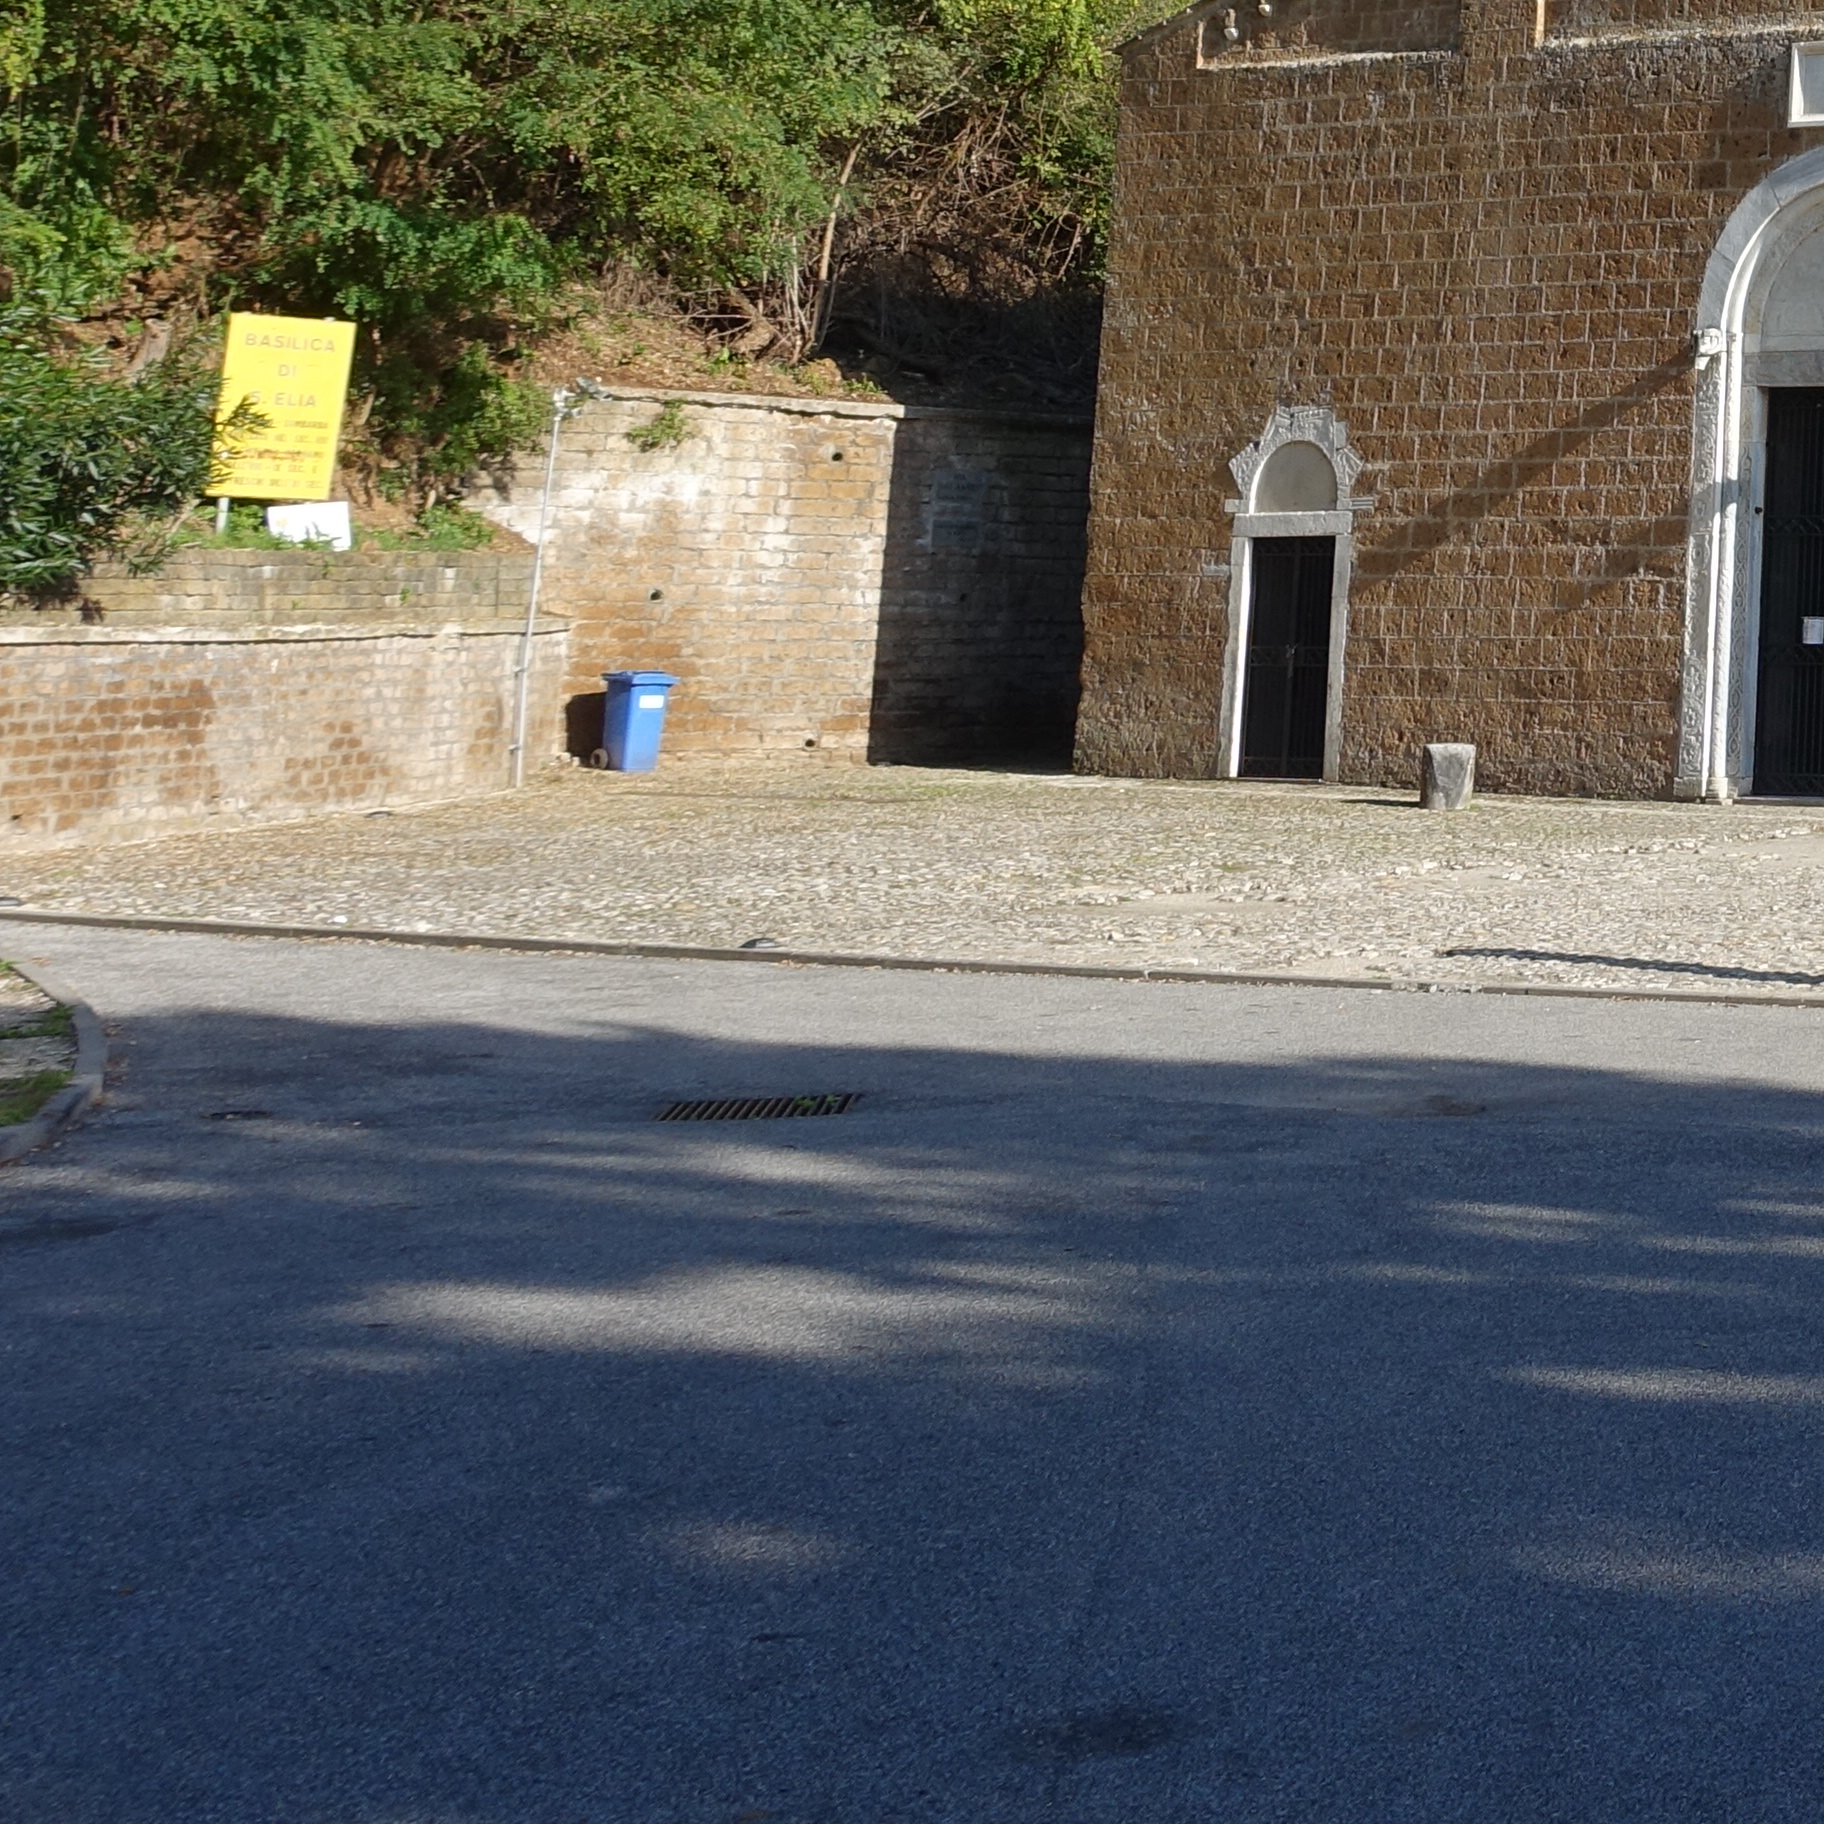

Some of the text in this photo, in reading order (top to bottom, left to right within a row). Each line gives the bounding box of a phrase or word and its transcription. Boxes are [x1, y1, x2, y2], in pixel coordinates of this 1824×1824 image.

[244, 333, 336, 353] BASILICA
[277, 364, 297, 378] DI
[274, 392, 317, 407] ELIA
